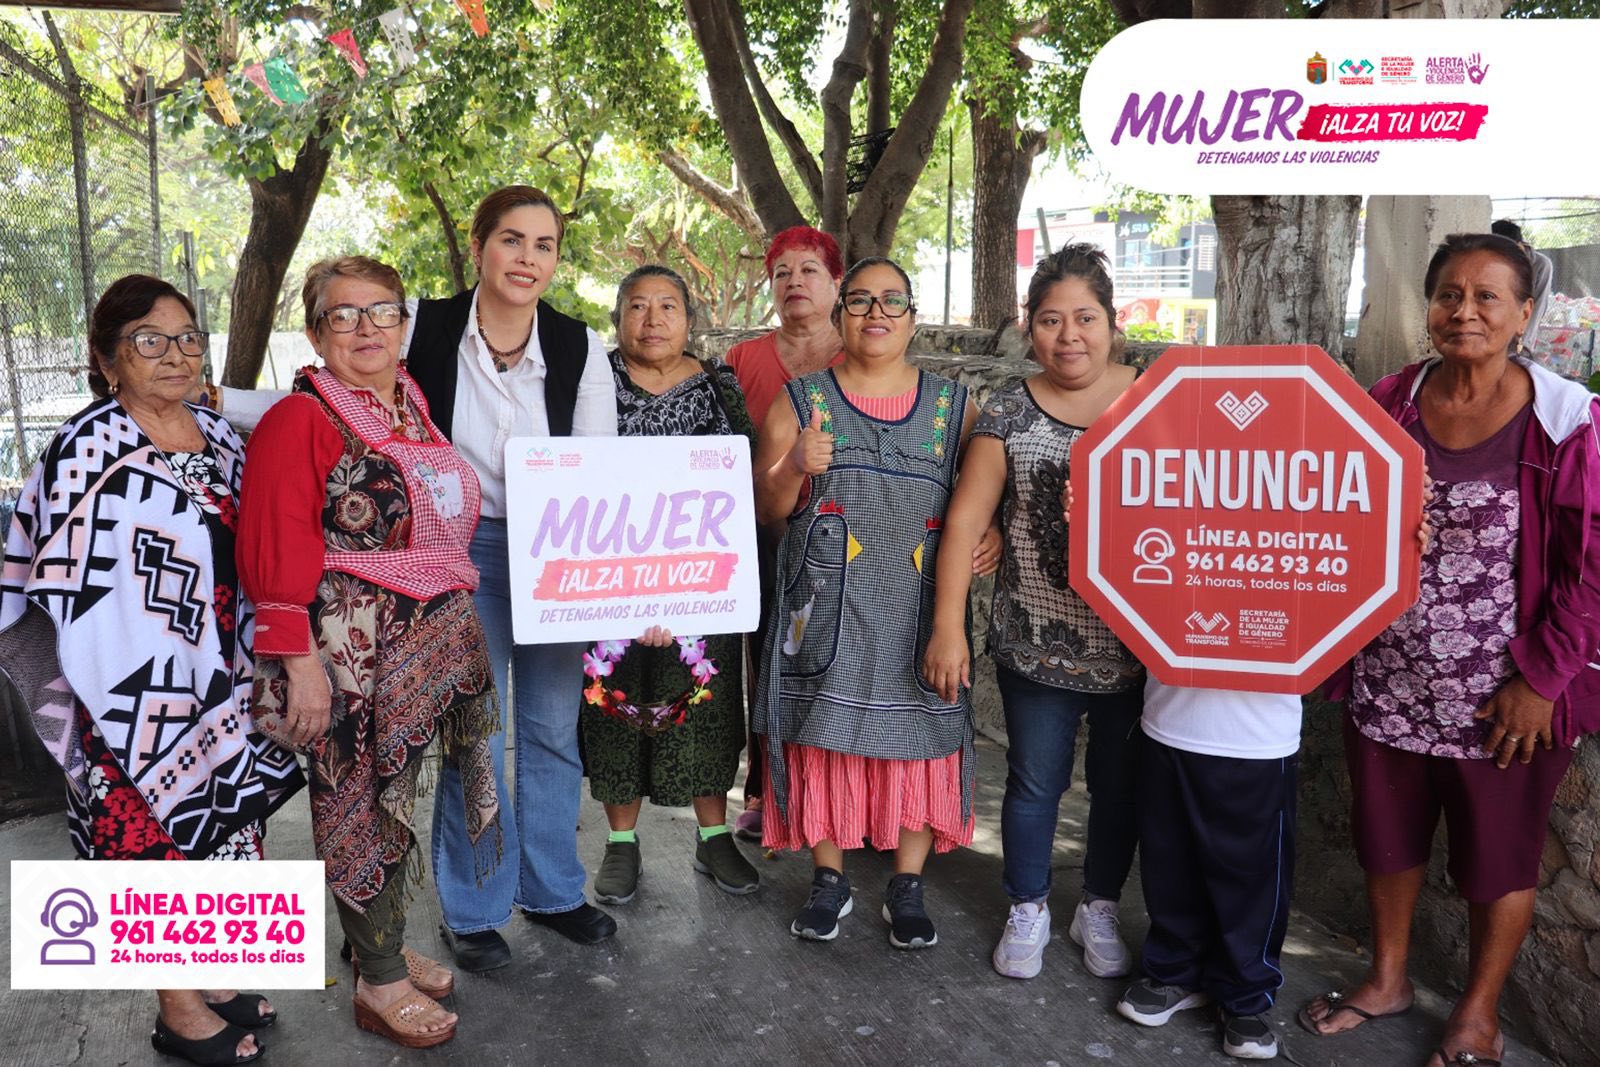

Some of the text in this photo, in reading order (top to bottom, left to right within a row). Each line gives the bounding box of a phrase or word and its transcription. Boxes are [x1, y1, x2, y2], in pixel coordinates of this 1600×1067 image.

[1121, 448, 1372, 513] DENUNCIA
[530, 490, 736, 559] MUJER
[1186, 524, 1348, 551] LÍNEA DIGITAL
[1185, 551, 1348, 576] 961 462 93 40
[559, 560, 716, 594] ¡ALZA TU VOZ!
[1185, 574, 1347, 593] 24 horas, todos los días
[540, 599, 736, 625] DETENGAMOS LAS VIOLENCIAS
[1239, 609, 1286, 618] SECRETARÍA
[1262, 617, 1290, 625] MUJER
[1246, 622, 1286, 631] IGUALDAD
[1250, 628, 1283, 638] GÉNERO
[1185, 638, 1230, 646] TRANSFORMA
